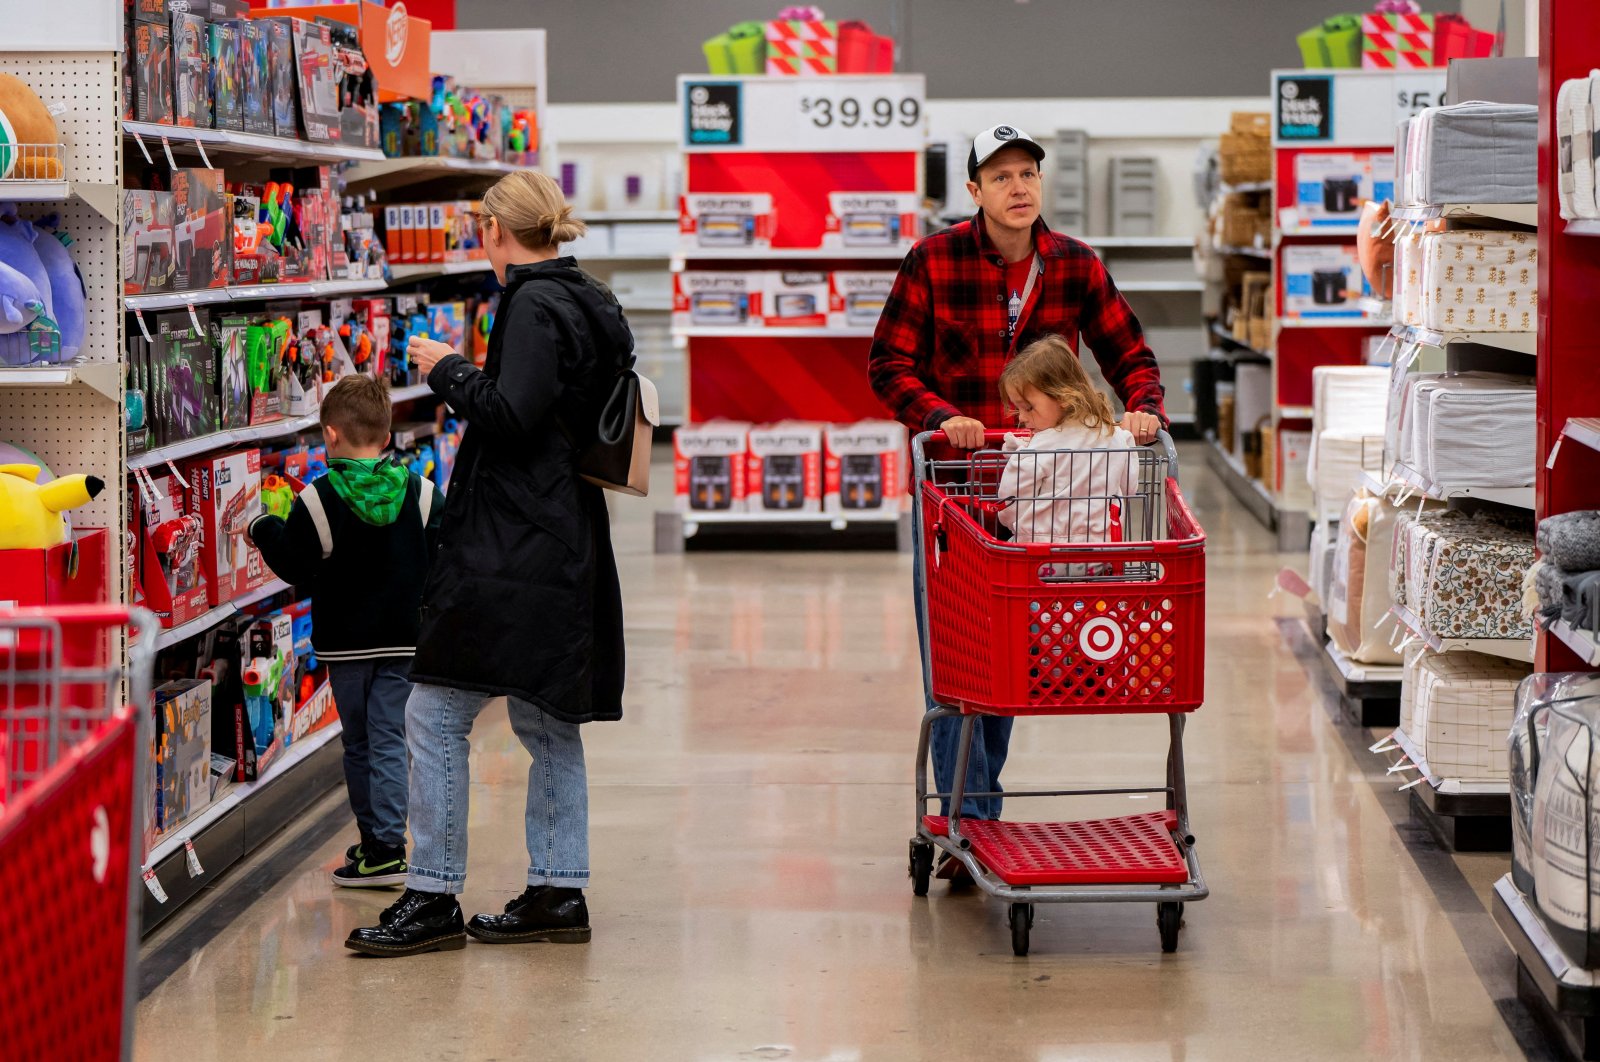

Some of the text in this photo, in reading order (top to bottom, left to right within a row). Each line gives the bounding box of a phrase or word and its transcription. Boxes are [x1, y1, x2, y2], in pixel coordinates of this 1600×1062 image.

[801, 97, 919, 128] $39.99
[188, 327, 196, 340] XL
[191, 468, 200, 512] HYPER
